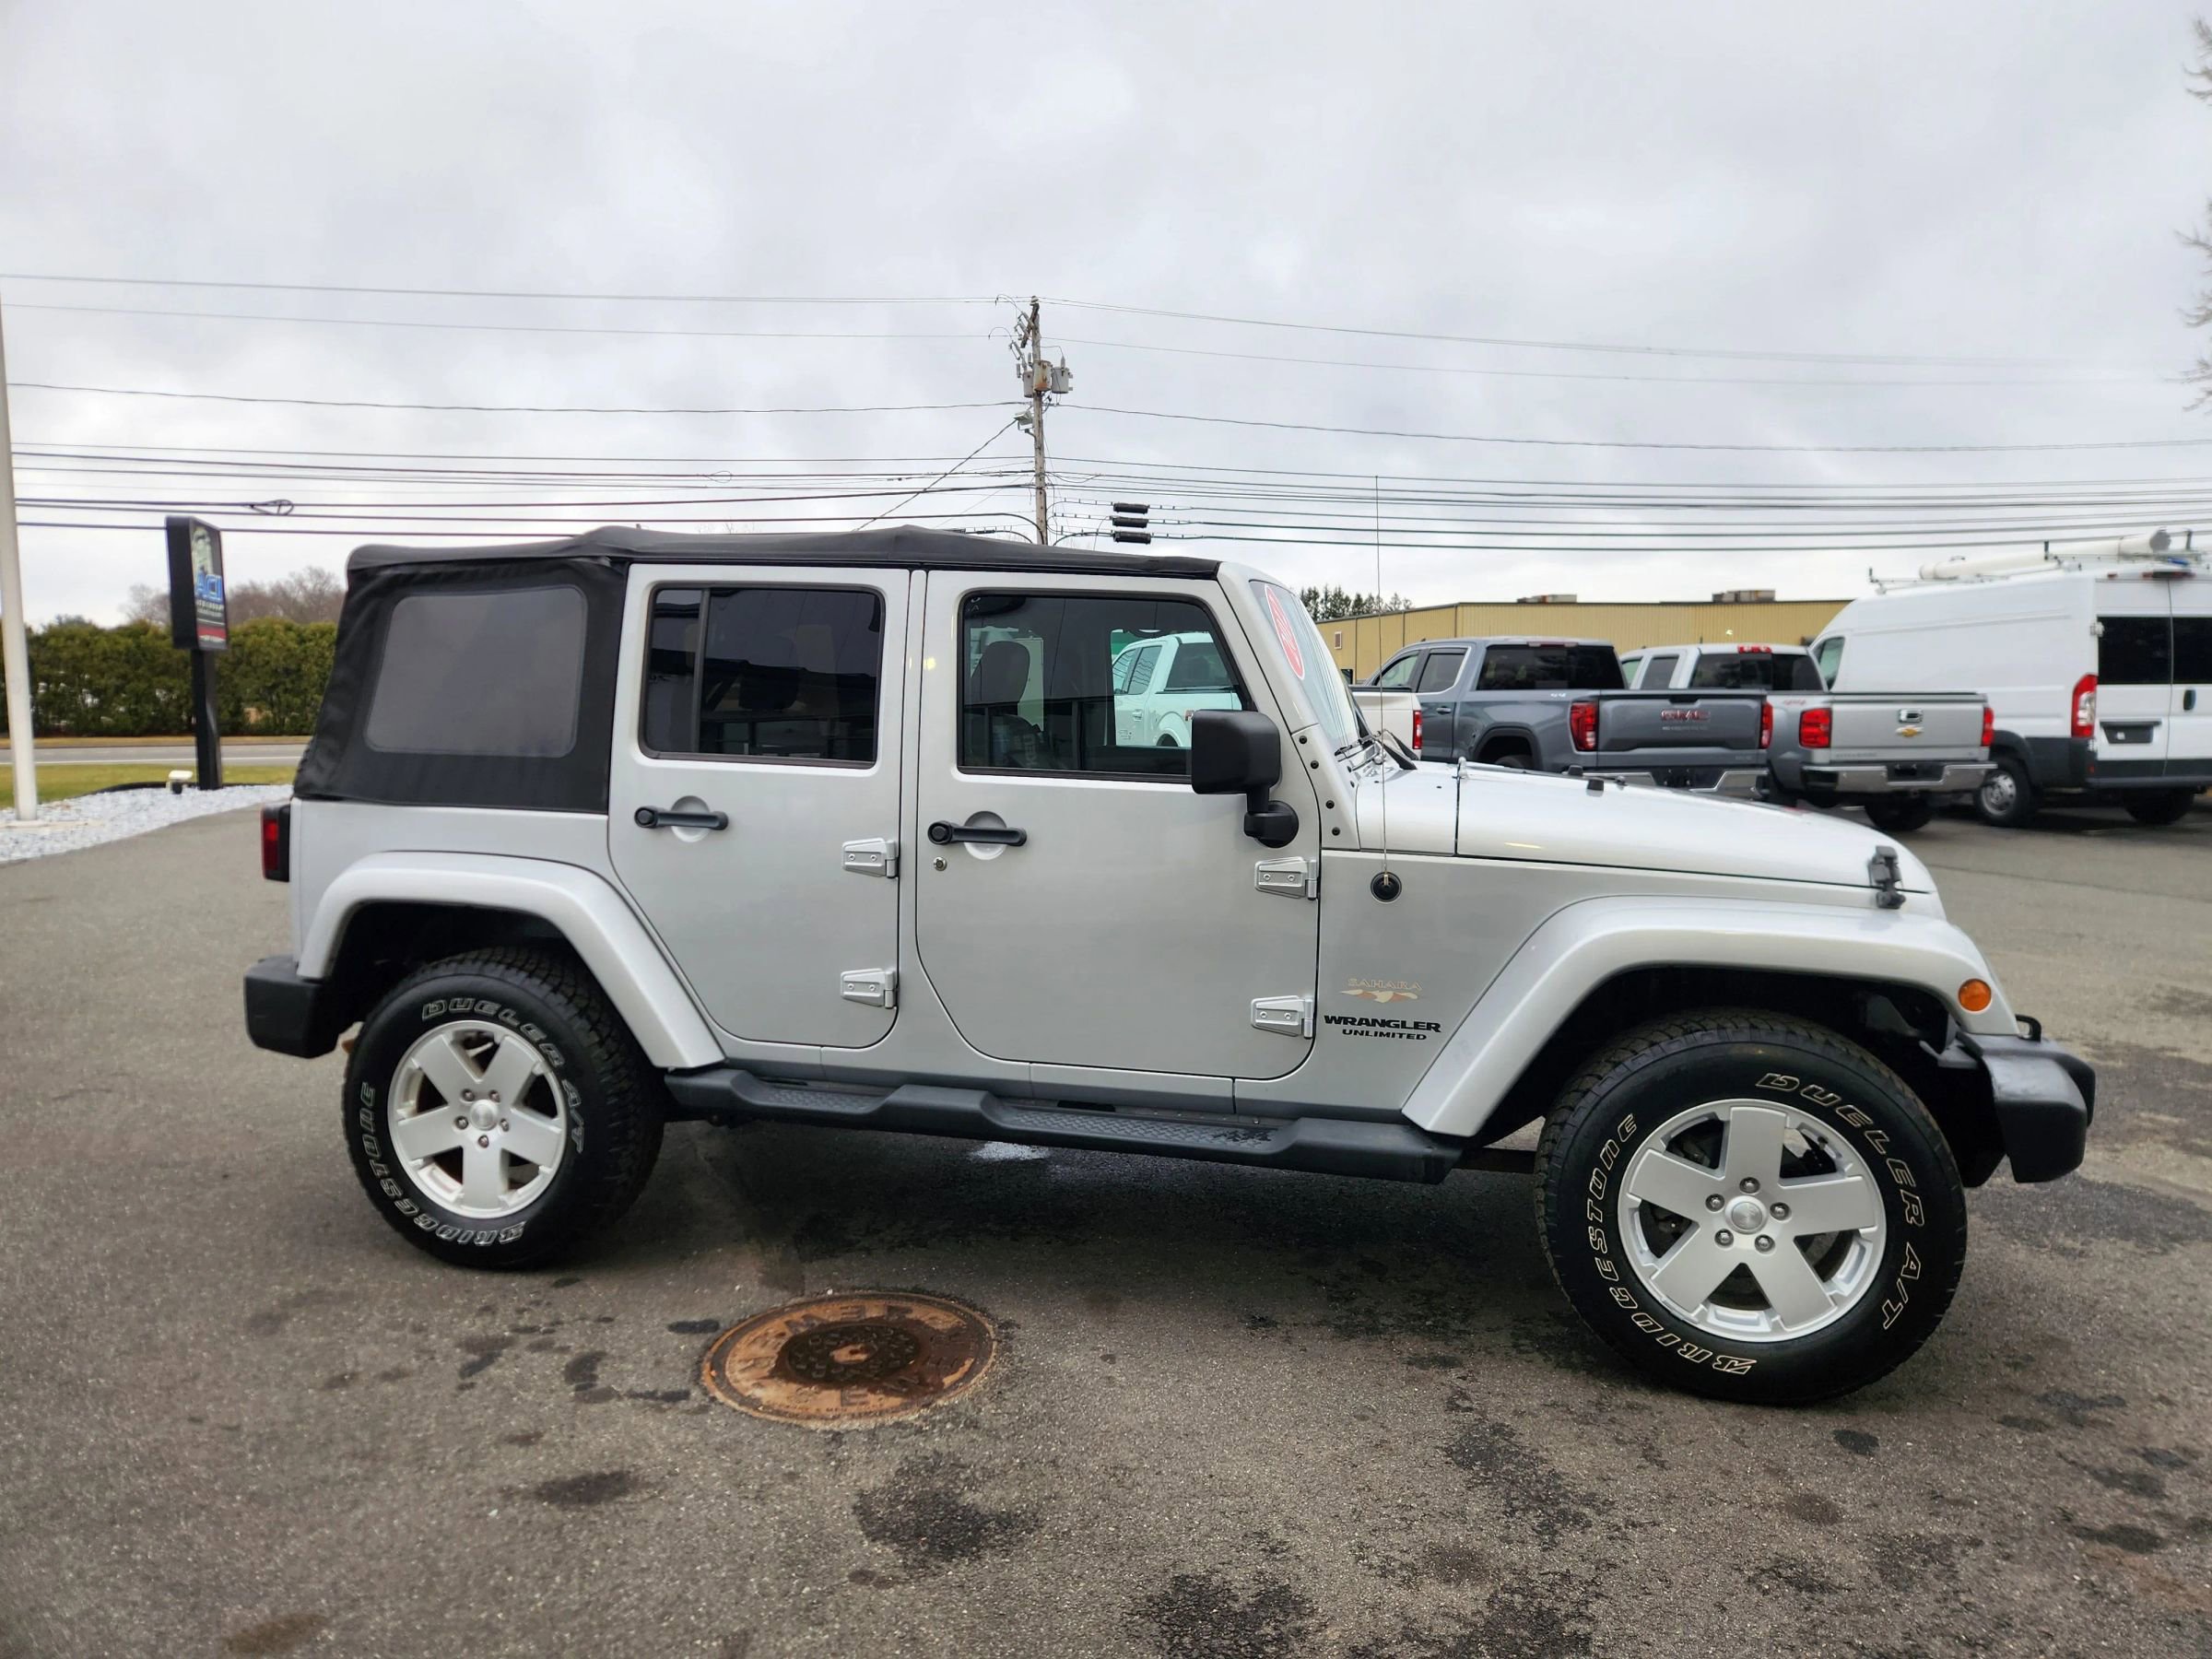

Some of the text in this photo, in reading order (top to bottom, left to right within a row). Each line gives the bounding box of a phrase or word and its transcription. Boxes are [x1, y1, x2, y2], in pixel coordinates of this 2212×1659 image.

[1347, 978, 1423, 991] SAHARA
[421, 997, 565, 1067] DUELER
[1324, 1015, 1441, 1033] WRANGLER
[1342, 1029, 1427, 1041] UNLIMITED
[359, 1082, 527, 1245] BRIDGESTONE
[1756, 1073, 1924, 1330] DUELER A/T
[1586, 1113, 1758, 1375] BRIDGESTONE
